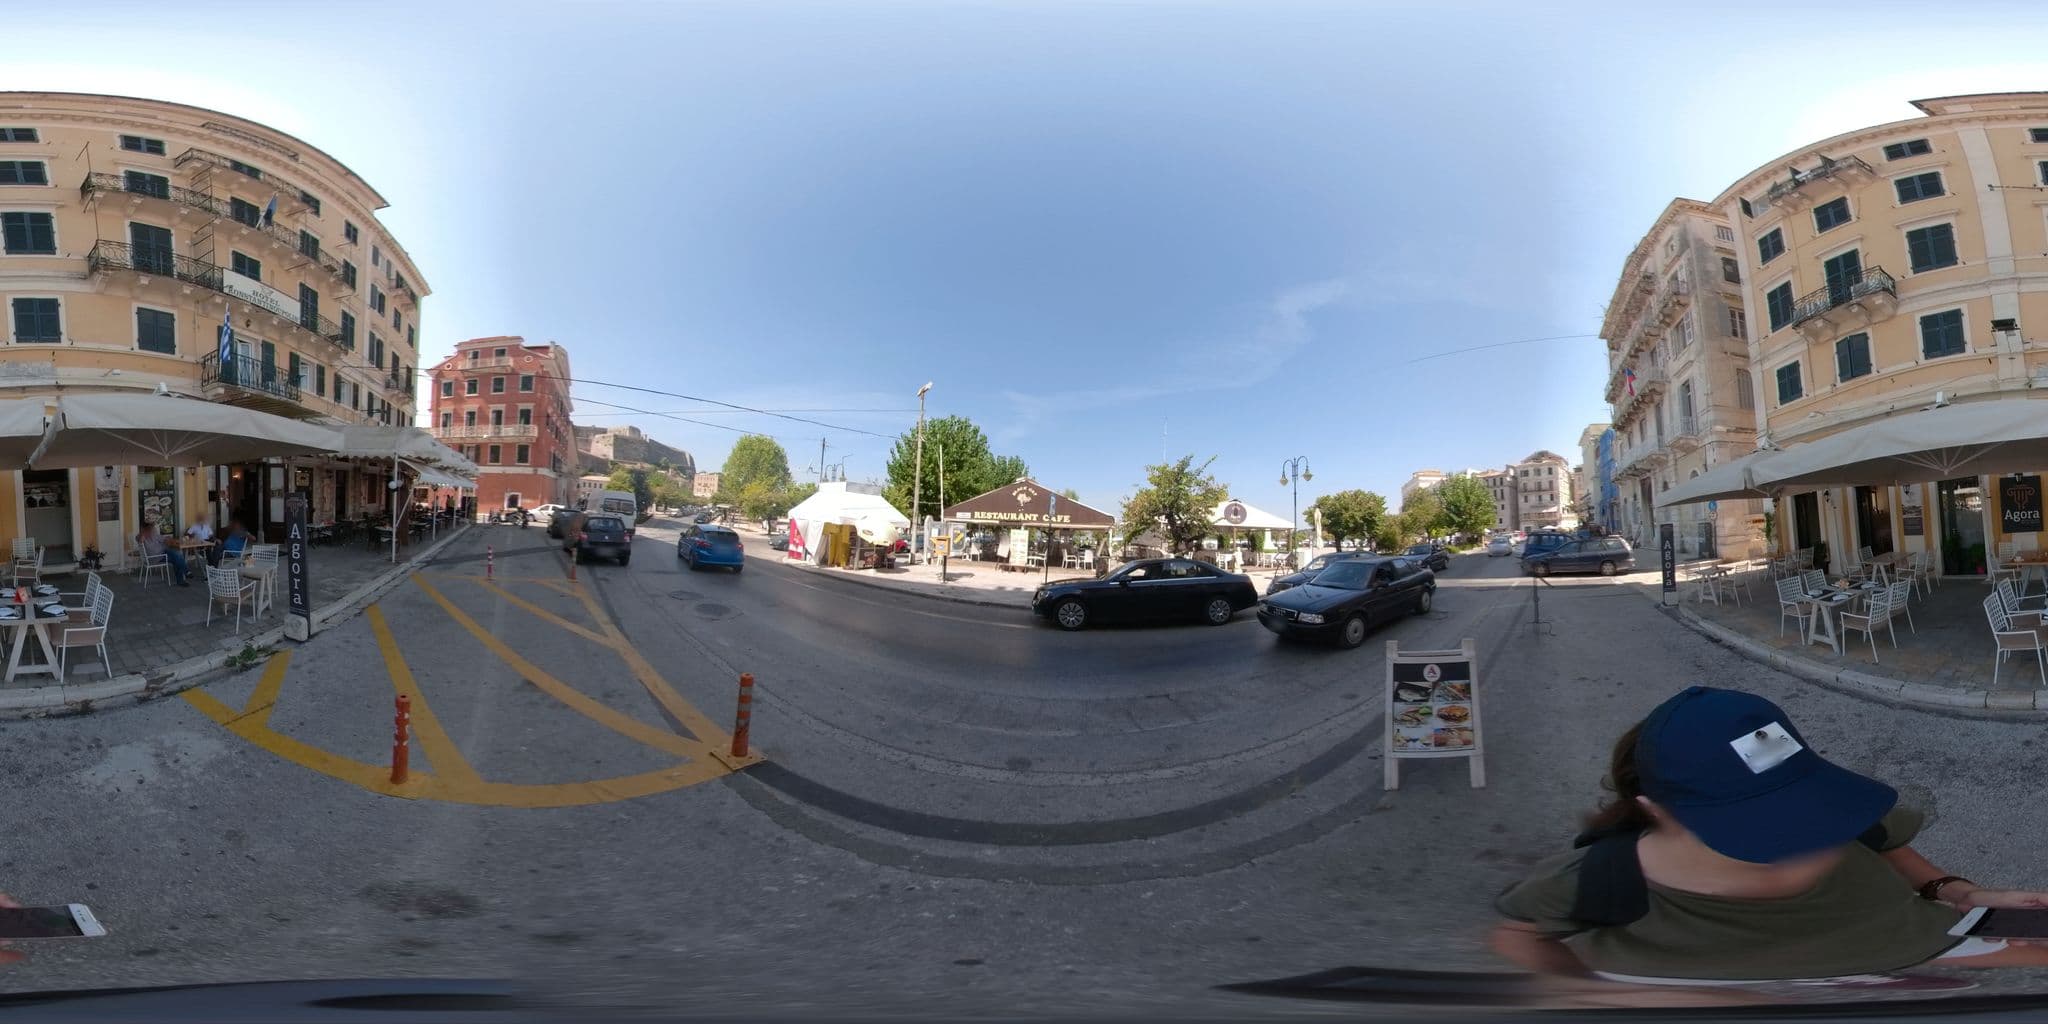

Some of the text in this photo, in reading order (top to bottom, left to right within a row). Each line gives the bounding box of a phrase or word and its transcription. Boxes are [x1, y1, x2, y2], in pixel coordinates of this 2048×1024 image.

[252, 289, 281, 306] HOTEL
[974, 511, 1039, 522] RESTAURANT
[2004, 509, 2040, 522] Agora
[290, 523, 303, 605] Agora
[1663, 540, 1673, 586] Agora
